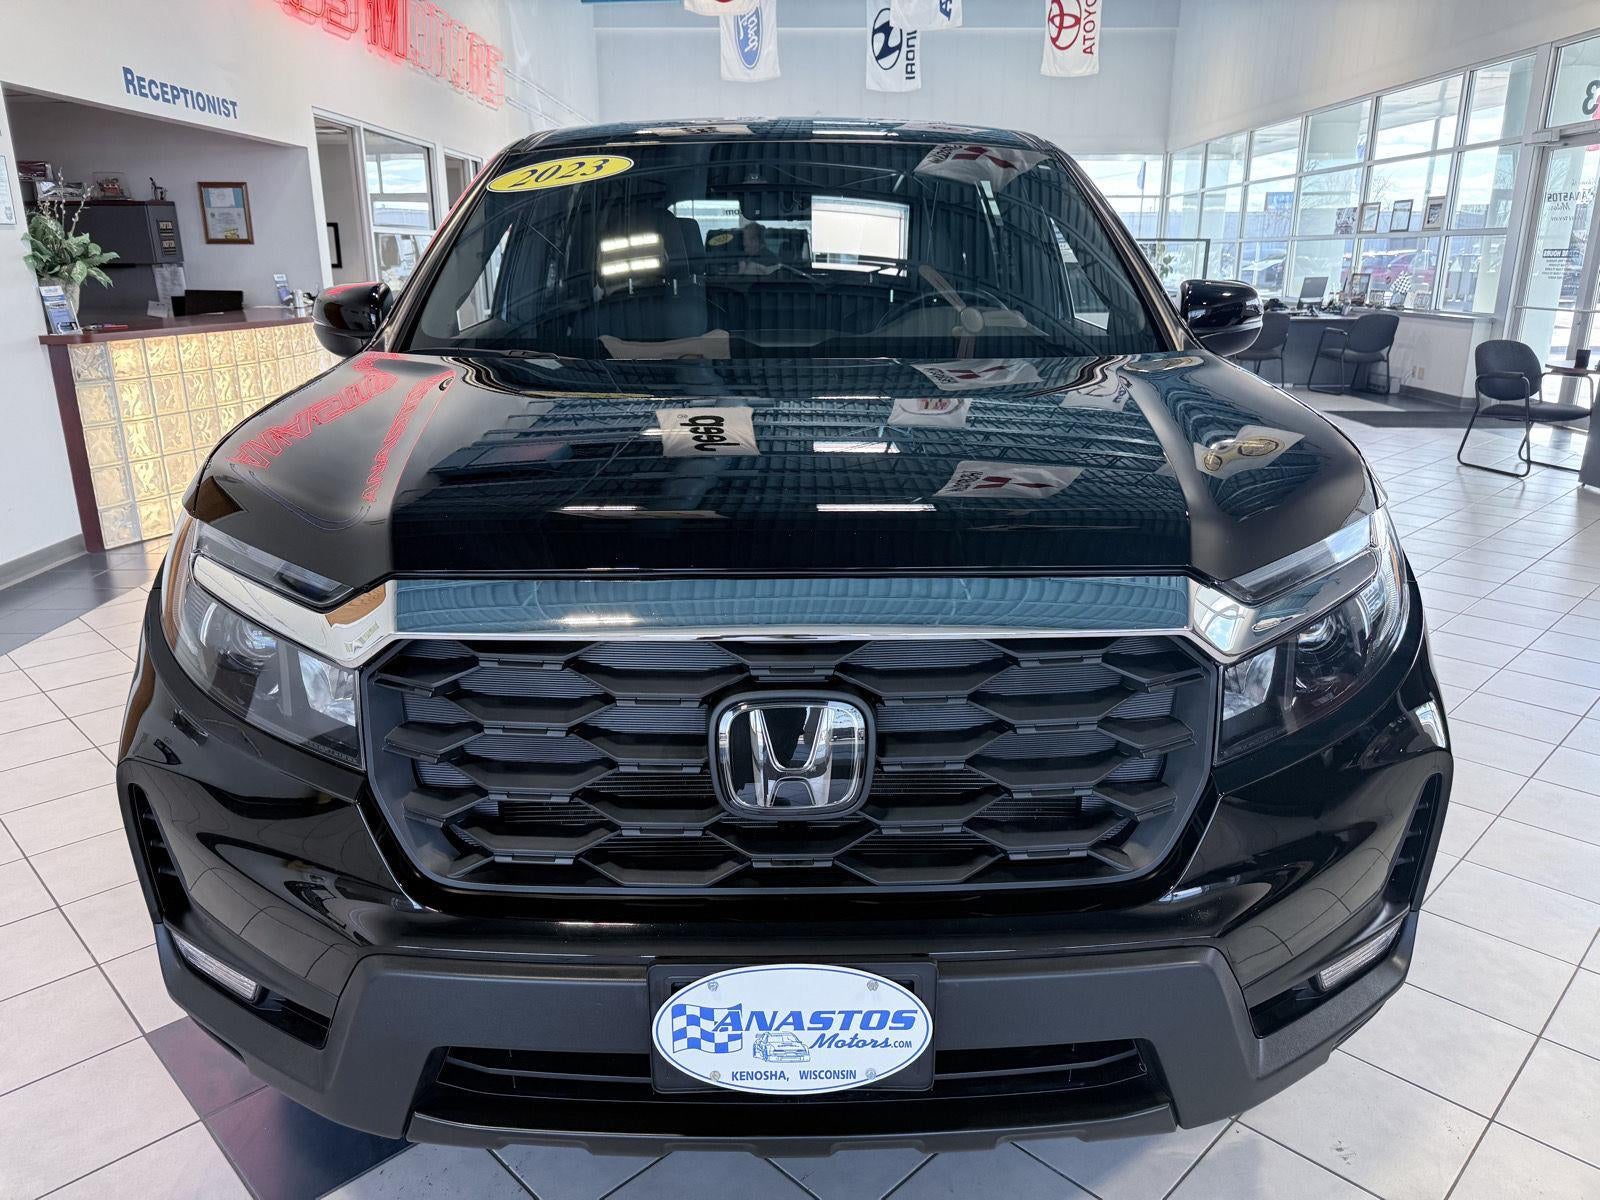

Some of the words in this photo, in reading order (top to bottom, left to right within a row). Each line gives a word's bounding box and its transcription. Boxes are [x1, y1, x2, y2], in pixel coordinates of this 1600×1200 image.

[507, 158, 610, 189] 2023
[712, 1009, 918, 1032] ANASTOS
[731, 1070, 789, 1082] KENOSHA,
[799, 1069, 857, 1080] WISCONSIN
